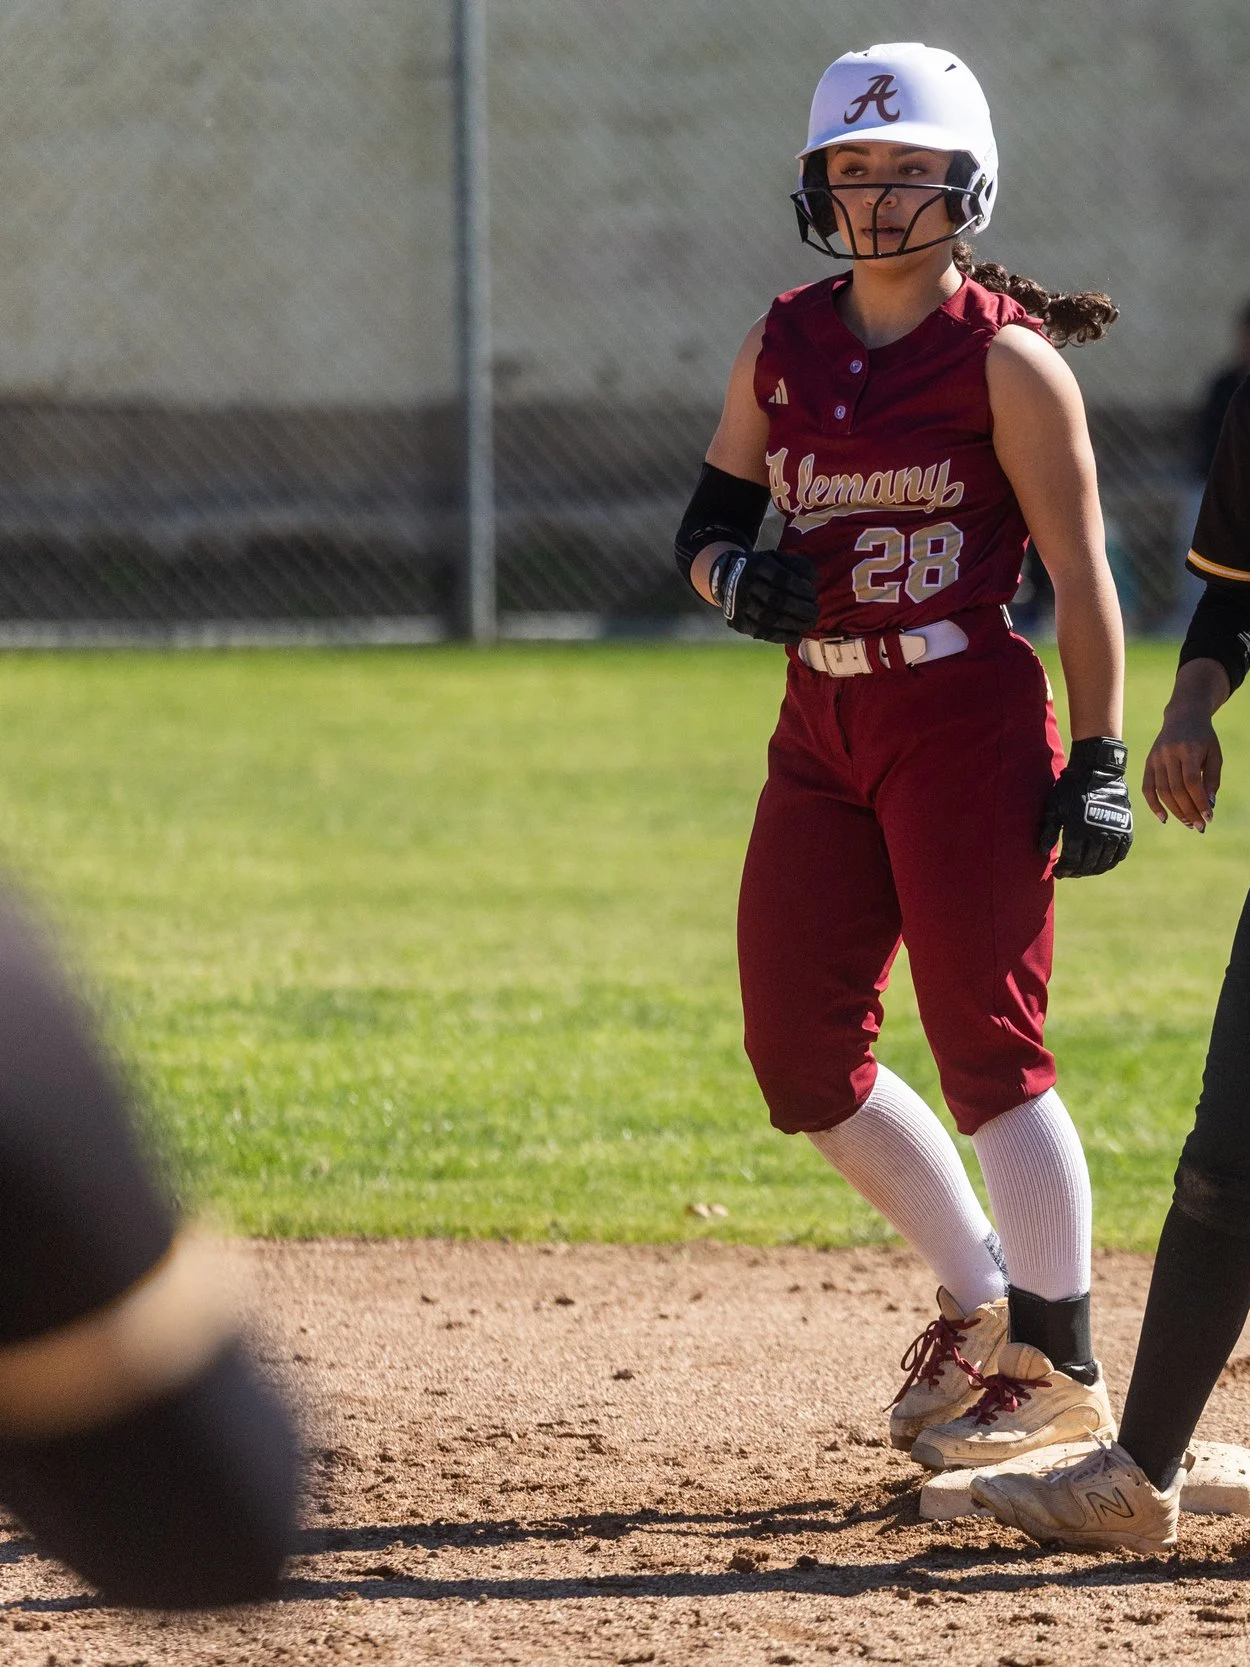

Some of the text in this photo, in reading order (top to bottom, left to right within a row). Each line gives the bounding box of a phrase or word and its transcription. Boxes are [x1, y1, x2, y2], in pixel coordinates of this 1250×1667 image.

[843, 74, 900, 125] A
[765, 447, 965, 516] Alemany
[852, 521, 964, 604] 28
